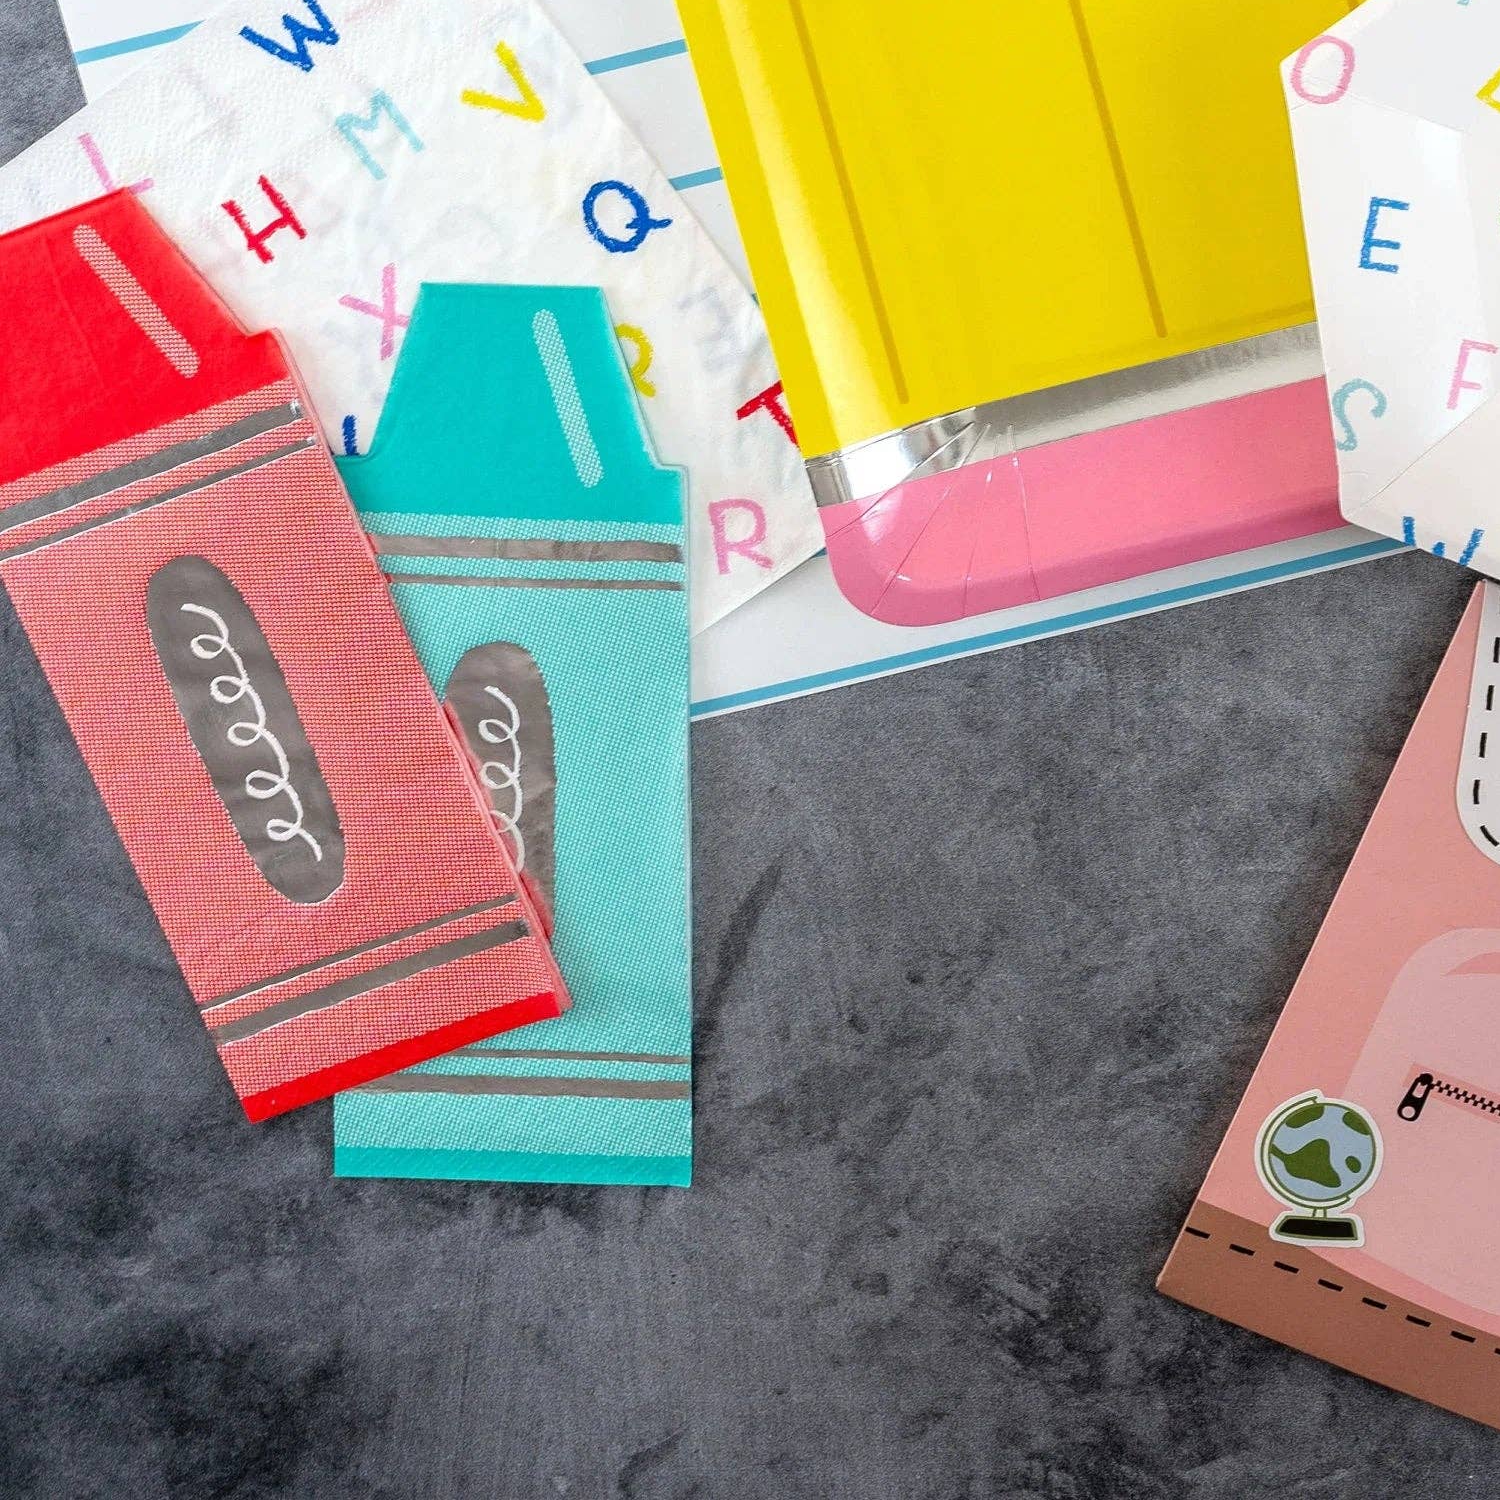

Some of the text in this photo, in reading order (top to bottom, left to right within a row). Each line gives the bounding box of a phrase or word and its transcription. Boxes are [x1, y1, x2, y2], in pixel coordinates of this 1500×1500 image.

[220, 174, 308, 264] H
[581, 179, 674, 255] Q
[1358, 196, 1410, 274] E
[1446, 339, 1499, 410] F
[708, 498, 774, 575] R
